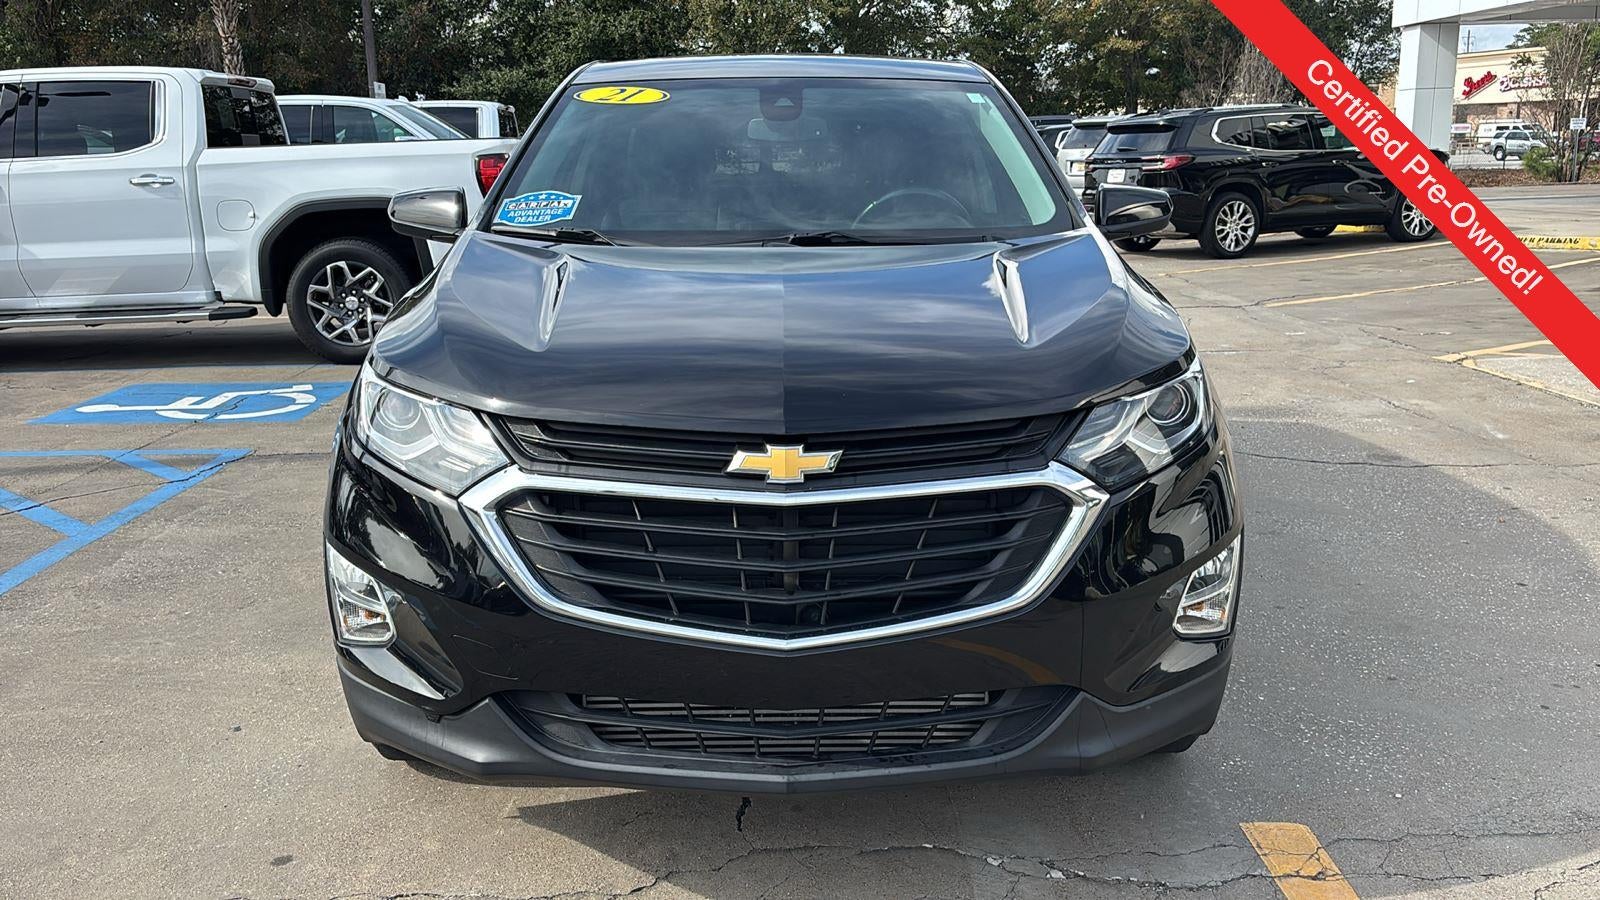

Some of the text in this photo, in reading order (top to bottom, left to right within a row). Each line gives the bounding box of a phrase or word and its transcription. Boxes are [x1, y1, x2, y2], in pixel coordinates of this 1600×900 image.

[593, 88, 647, 102] 21
[506, 199, 574, 211] CARFAX
[507, 208, 564, 218] ADVANTAGE
[513, 215, 551, 223] DEALER
[1537, 237, 1581, 245] PARKING
